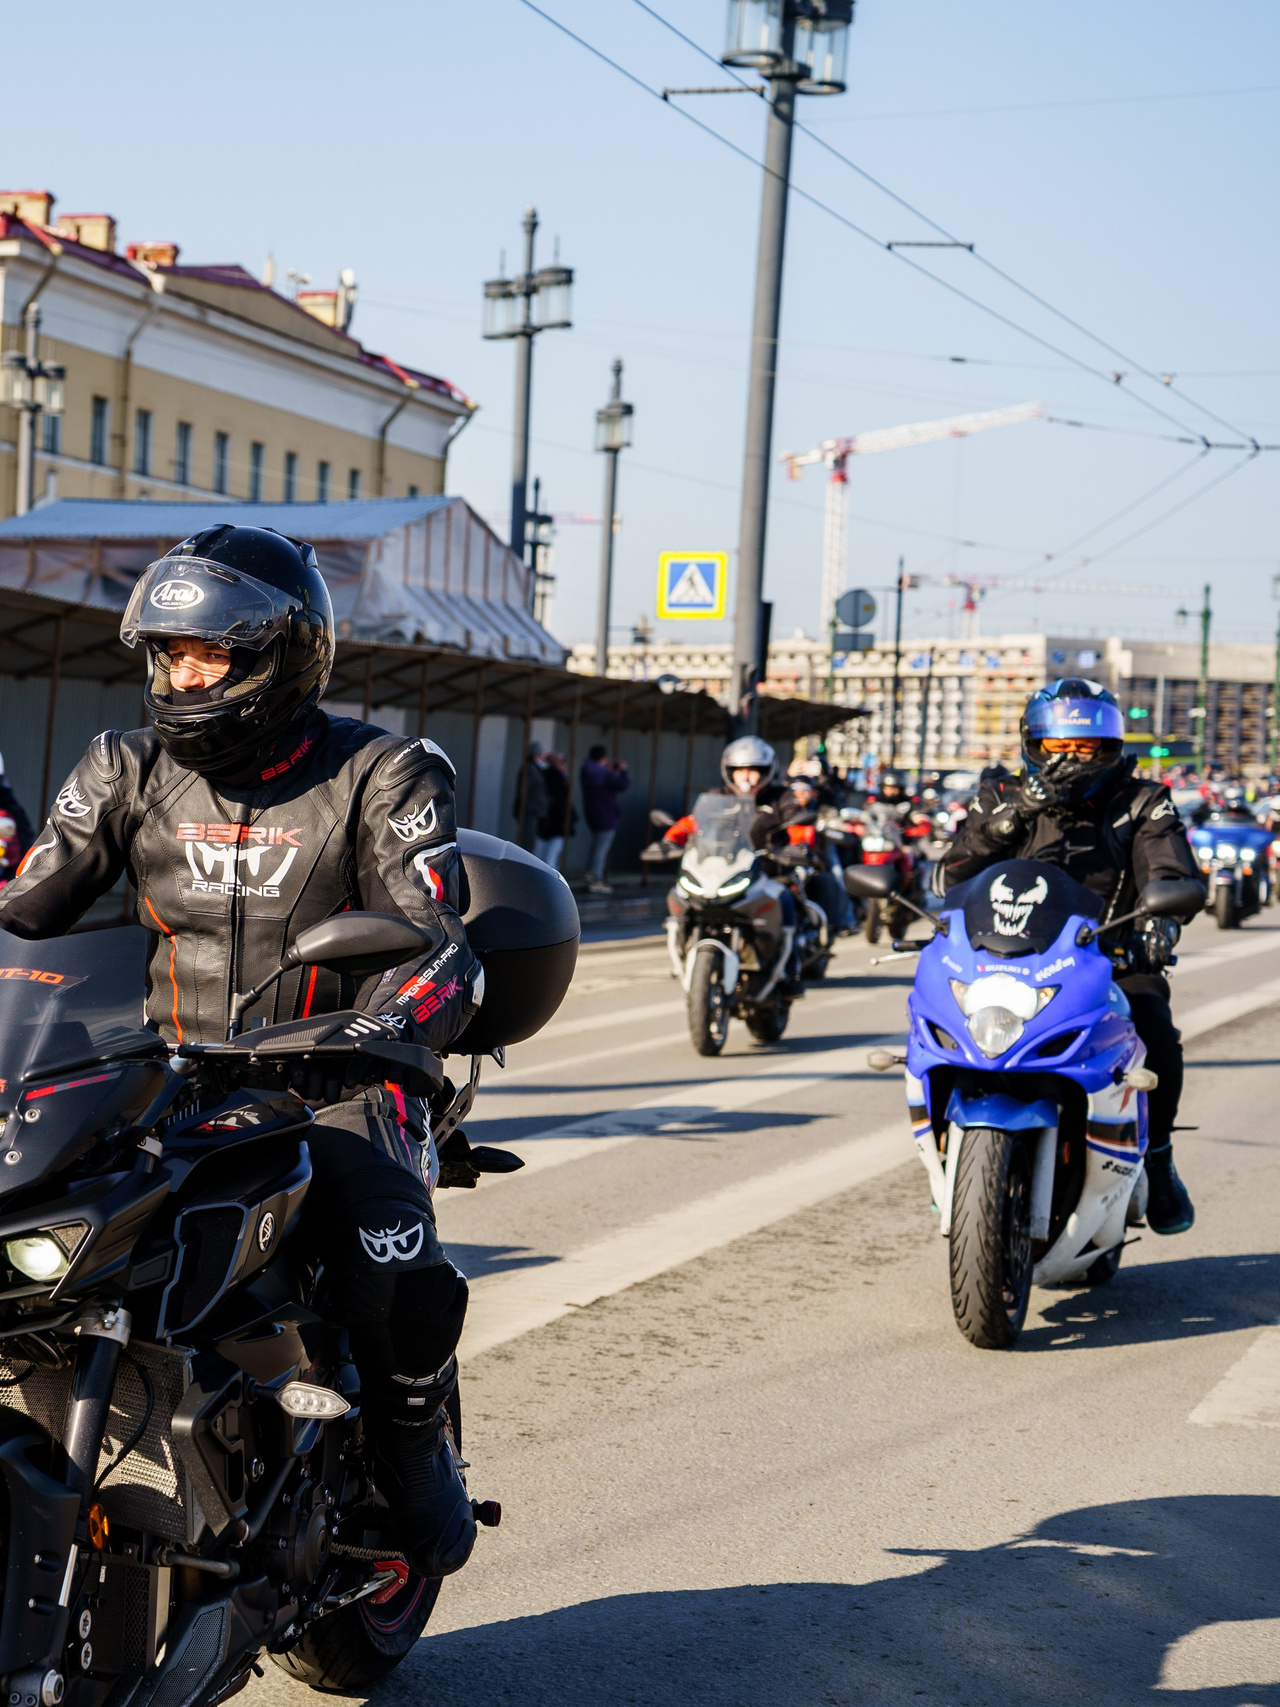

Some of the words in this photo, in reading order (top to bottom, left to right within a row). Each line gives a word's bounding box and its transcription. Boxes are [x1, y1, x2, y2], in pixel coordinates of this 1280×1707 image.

[154, 582, 196, 602] Arai
[260, 735, 313, 781] BERIK
[176, 822, 304, 847] BERIK
[191, 880, 280, 898] RACING
[411, 974, 463, 1025] BERIK
